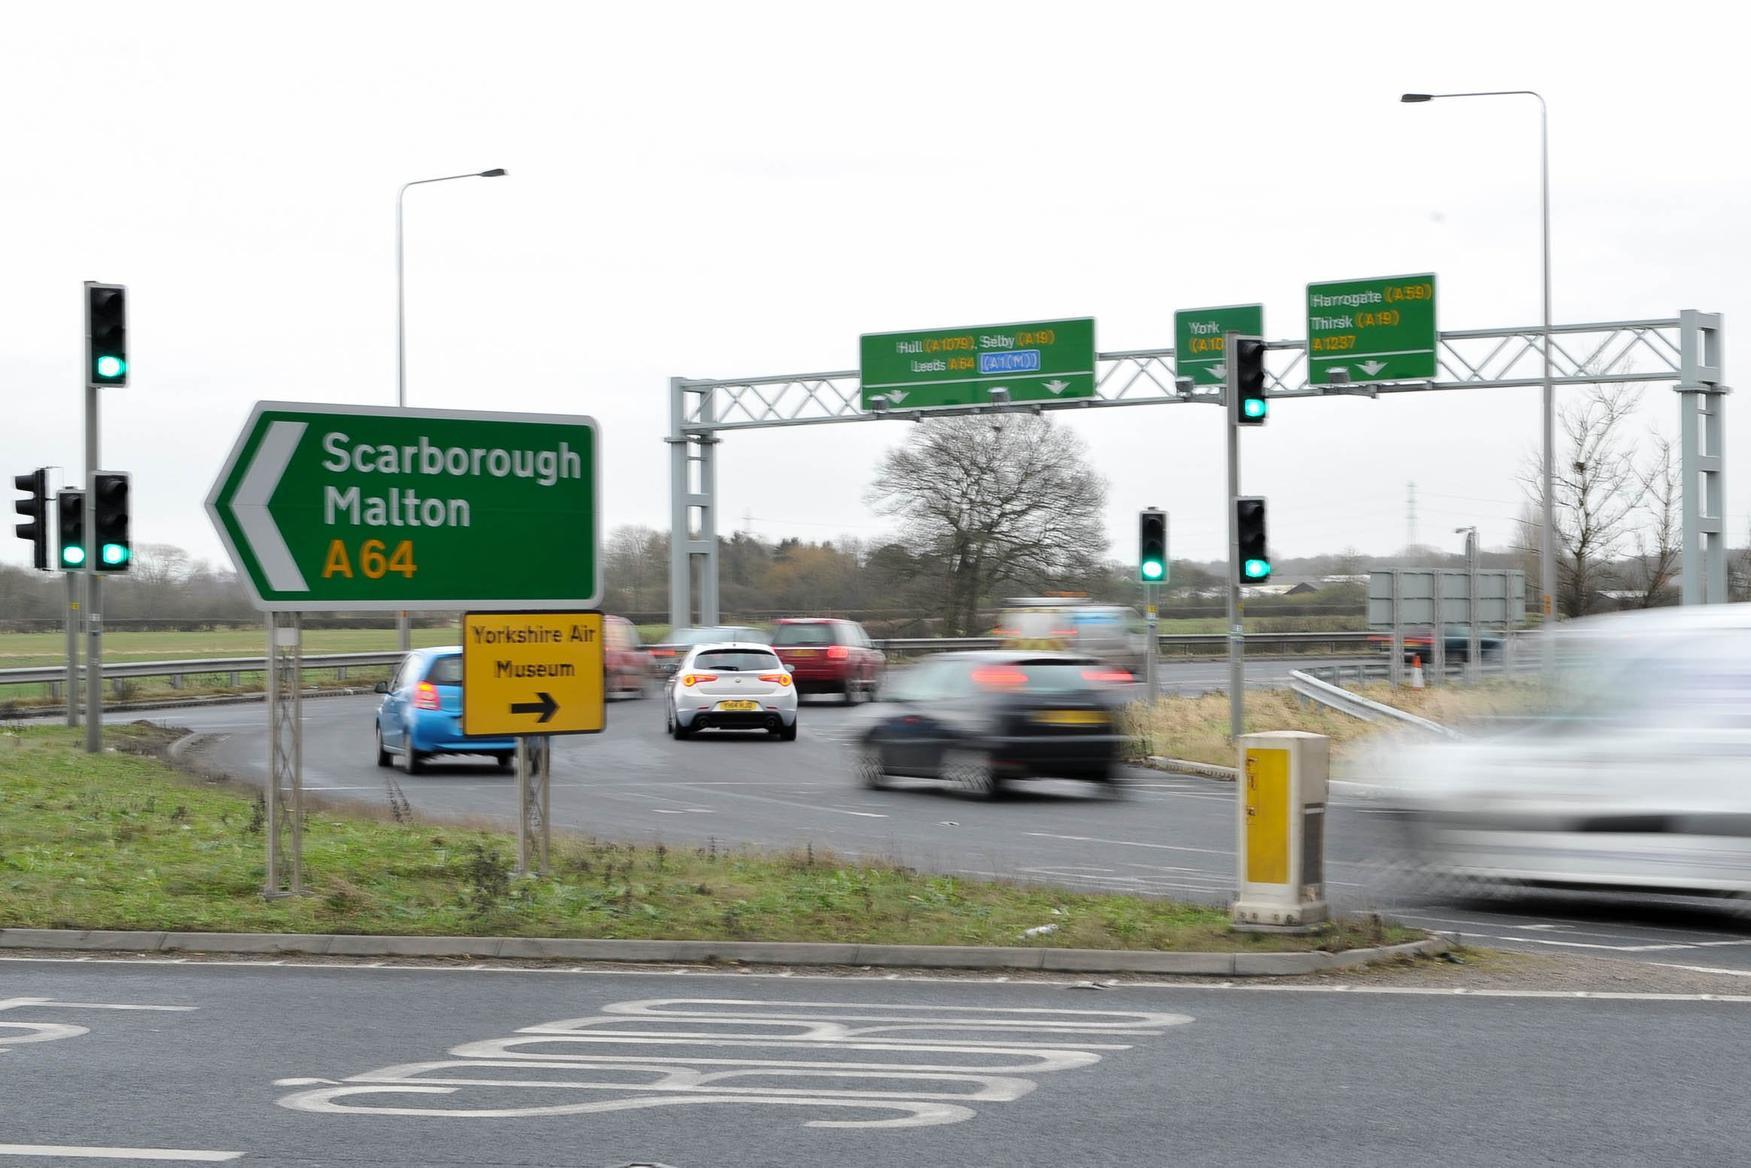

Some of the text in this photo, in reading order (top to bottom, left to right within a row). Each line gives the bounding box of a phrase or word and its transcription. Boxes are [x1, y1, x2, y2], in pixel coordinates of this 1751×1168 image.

[1310, 283, 1432, 307] Harrogate (A59)
[1189, 321, 1220, 334] York
[1309, 310, 1400, 330] Thirsk (A19)
[896, 341, 923, 353] Hull
[979, 335, 1015, 349] Selby
[1016, 330, 1055, 347] (A19)
[1312, 335, 1356, 350] A1237
[911, 359, 946, 373] Leeds
[322, 432, 582, 486] Scarborough
[323, 486, 470, 527] Malton
[321, 539, 417, 579] A64
[473, 625, 597, 644] Yorkshire Air
[494, 660, 576, 679] Museum
